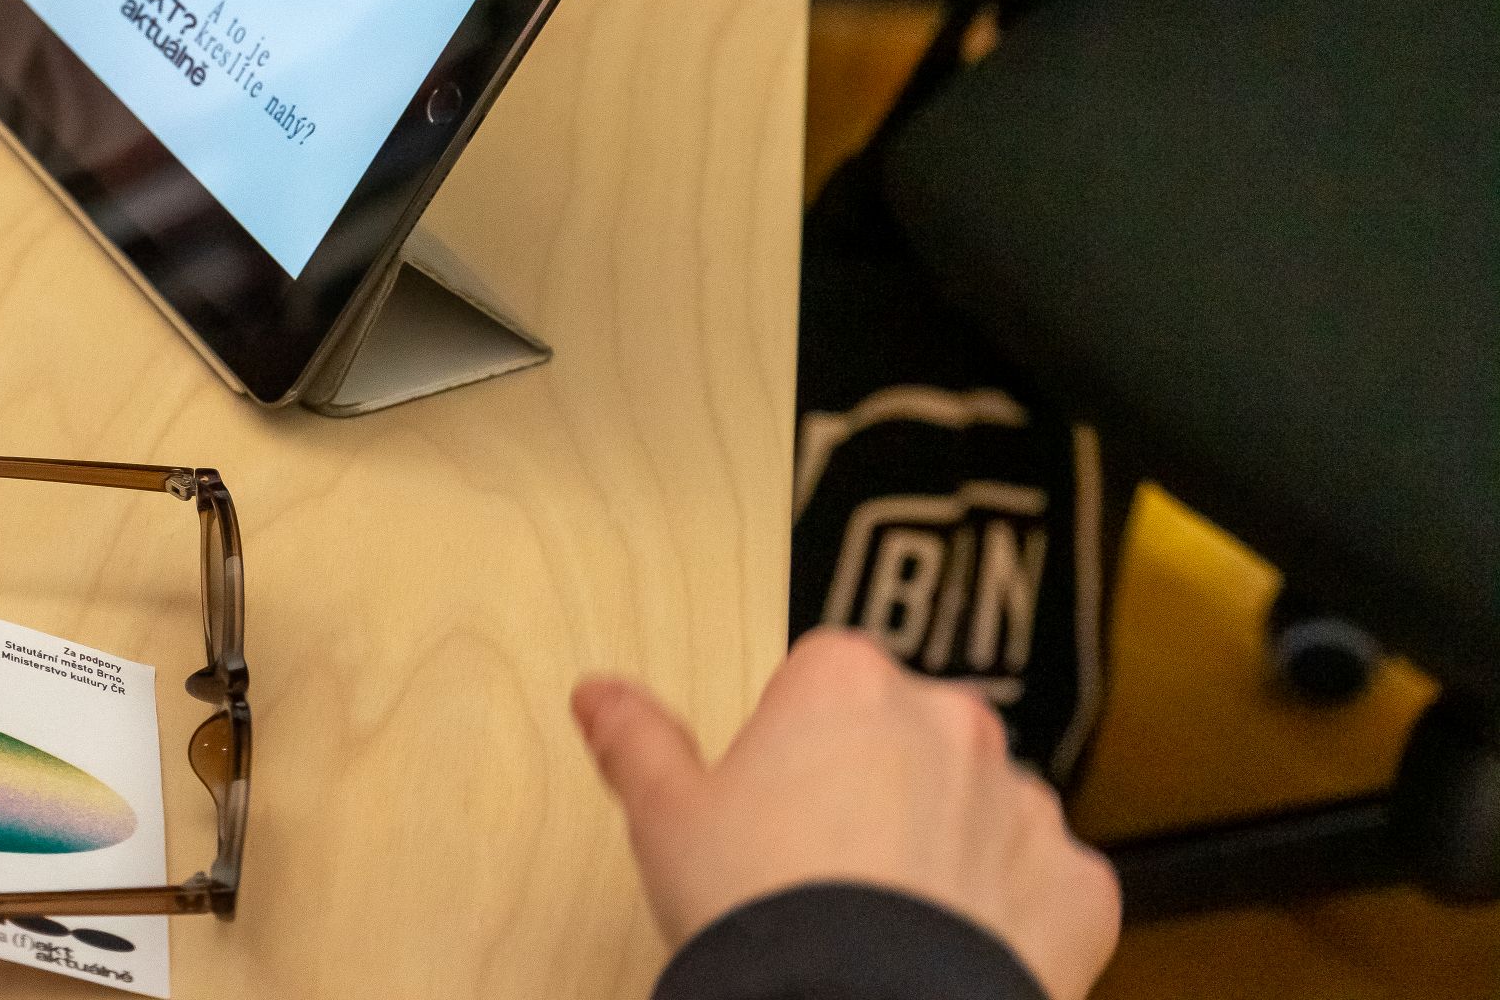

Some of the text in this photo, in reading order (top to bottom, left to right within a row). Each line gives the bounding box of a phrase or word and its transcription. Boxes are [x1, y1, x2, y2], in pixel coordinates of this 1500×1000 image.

[207, 0, 271, 68] A to je
[193, 20, 316, 146] kreslíte nahý?
[1, 650, 126, 696] Ministerstvo kultury ČR
[4, 640, 125, 686] Statutární město Brno,
[63, 646, 122, 674] Za podpory
